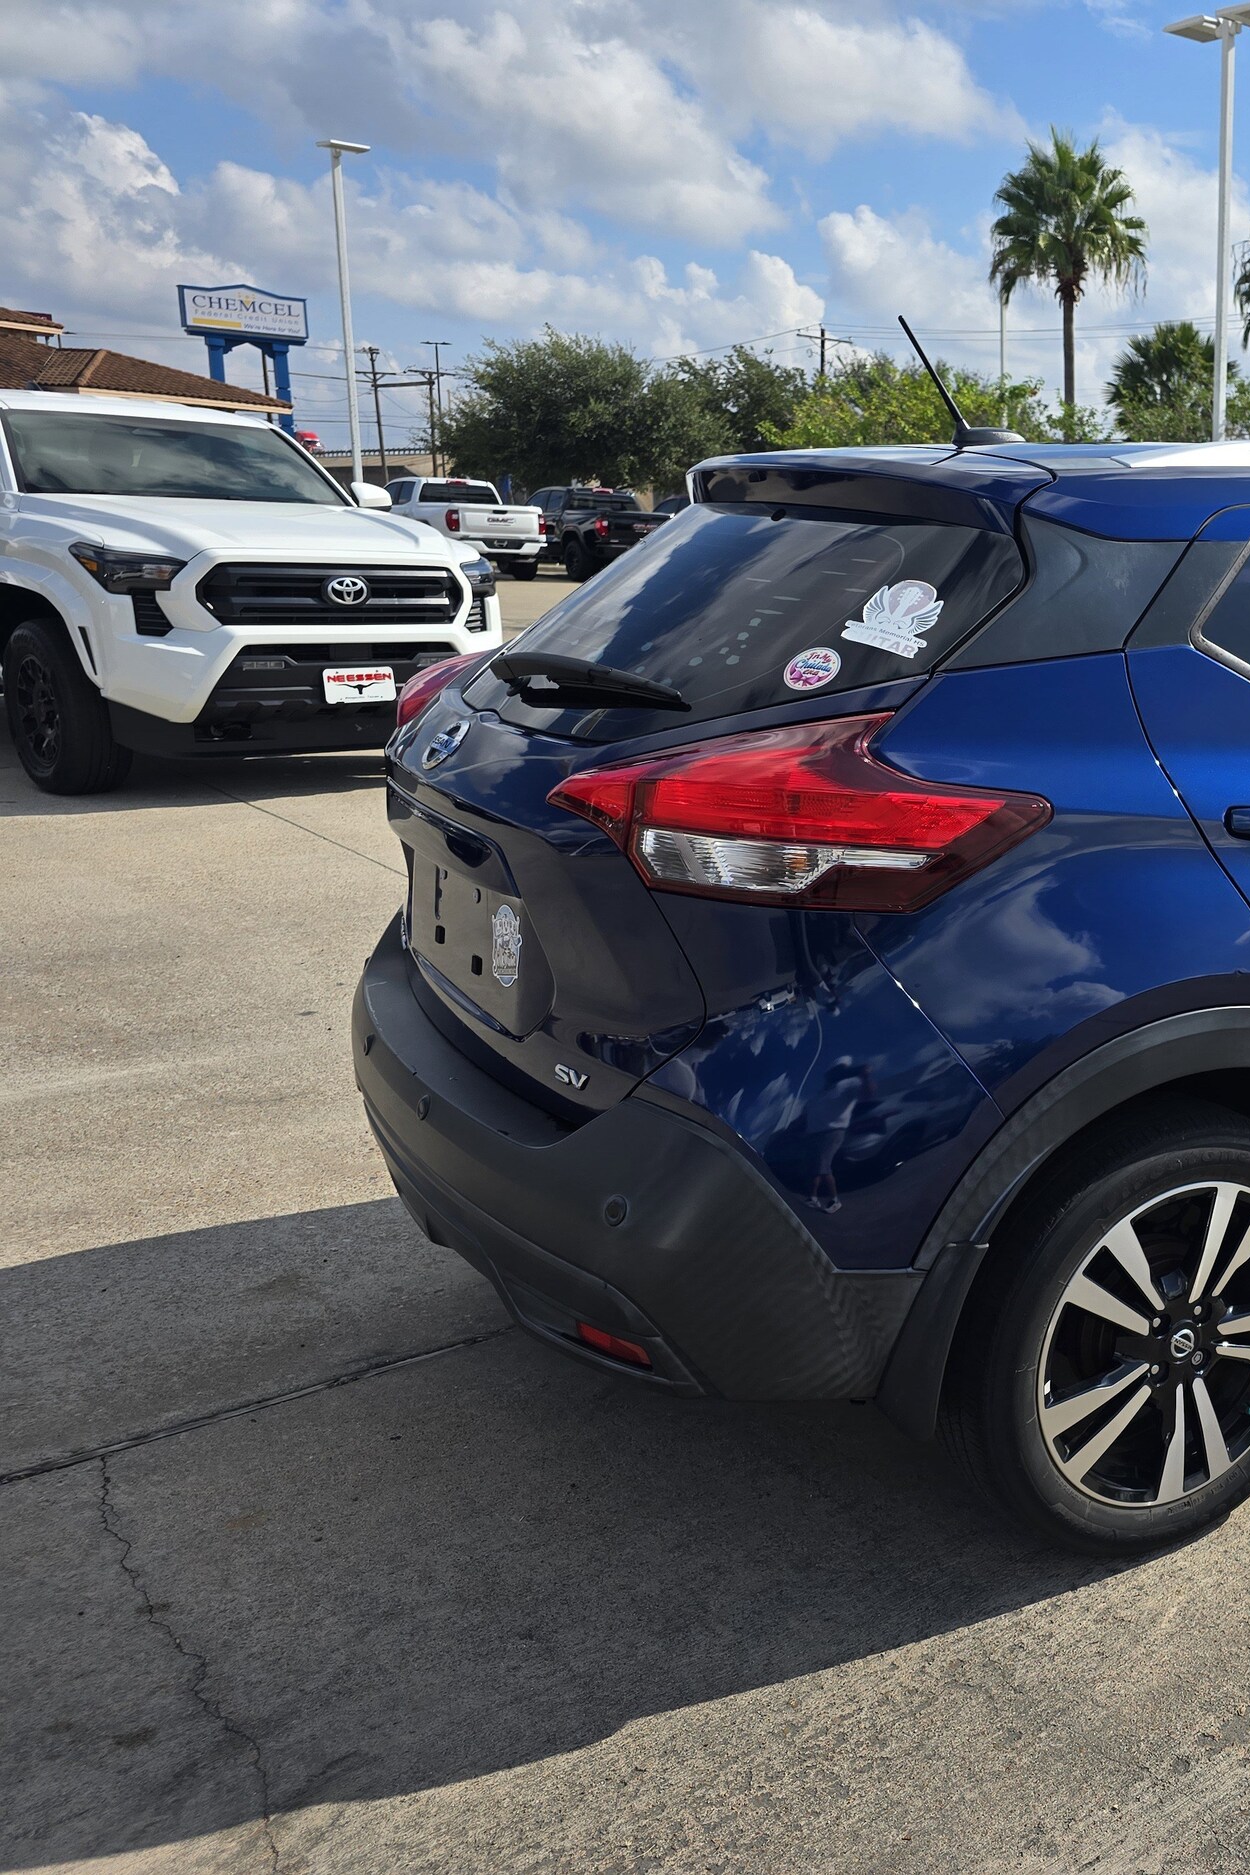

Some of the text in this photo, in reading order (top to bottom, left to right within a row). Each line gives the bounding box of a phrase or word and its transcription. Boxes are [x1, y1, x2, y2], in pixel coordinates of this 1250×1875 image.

[192, 294, 300, 317] CHEMCEL
[194, 308, 299, 325] Federal Credit Union
[879, 628, 913, 643] Memorial
[326, 673, 392, 683] NEESSEN
[554, 1063, 589, 1089] SV
